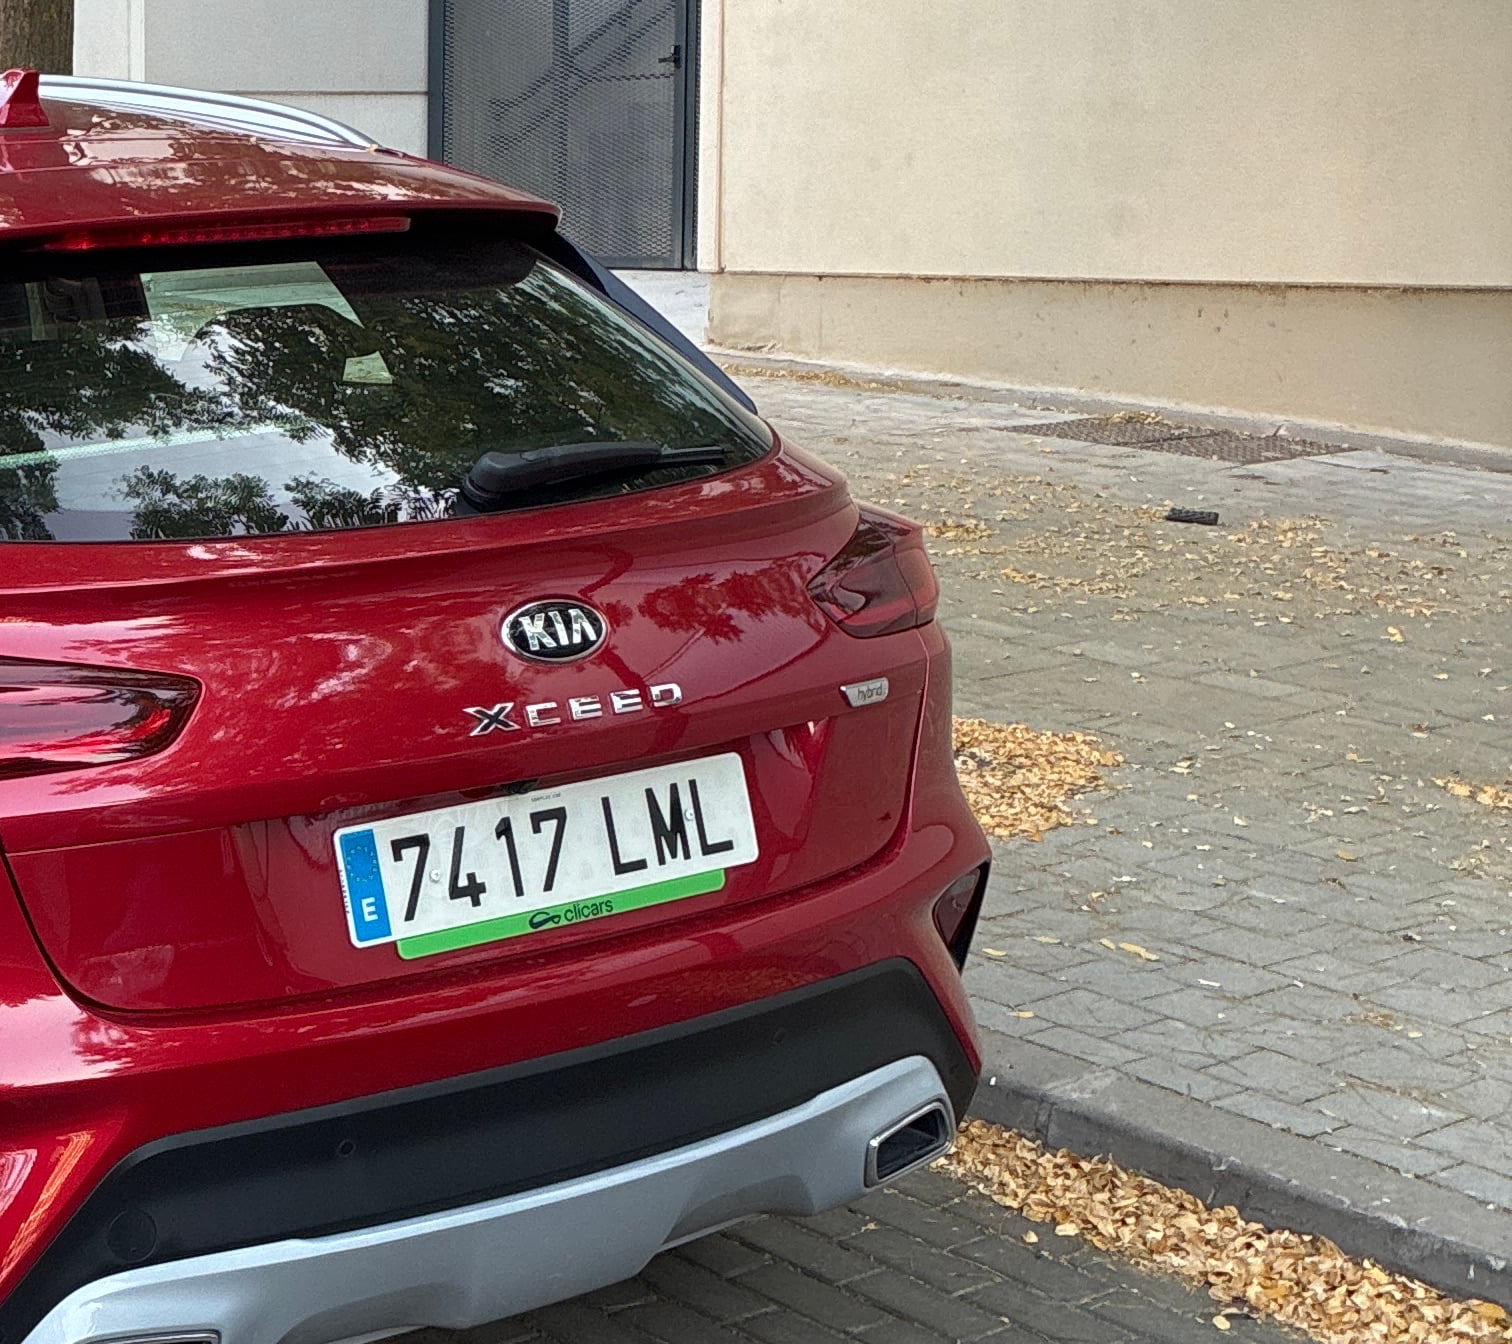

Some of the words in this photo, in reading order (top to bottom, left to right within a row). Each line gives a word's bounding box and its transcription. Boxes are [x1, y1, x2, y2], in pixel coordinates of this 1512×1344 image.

[519, 608, 597, 651] KIA
[857, 680, 883, 702] hybrid
[462, 682, 683, 737] XCEED
[390, 806, 567, 922] 7417
[601, 778, 734, 876] LML
[361, 897, 378, 922] E
[563, 899, 614, 922] clicars
